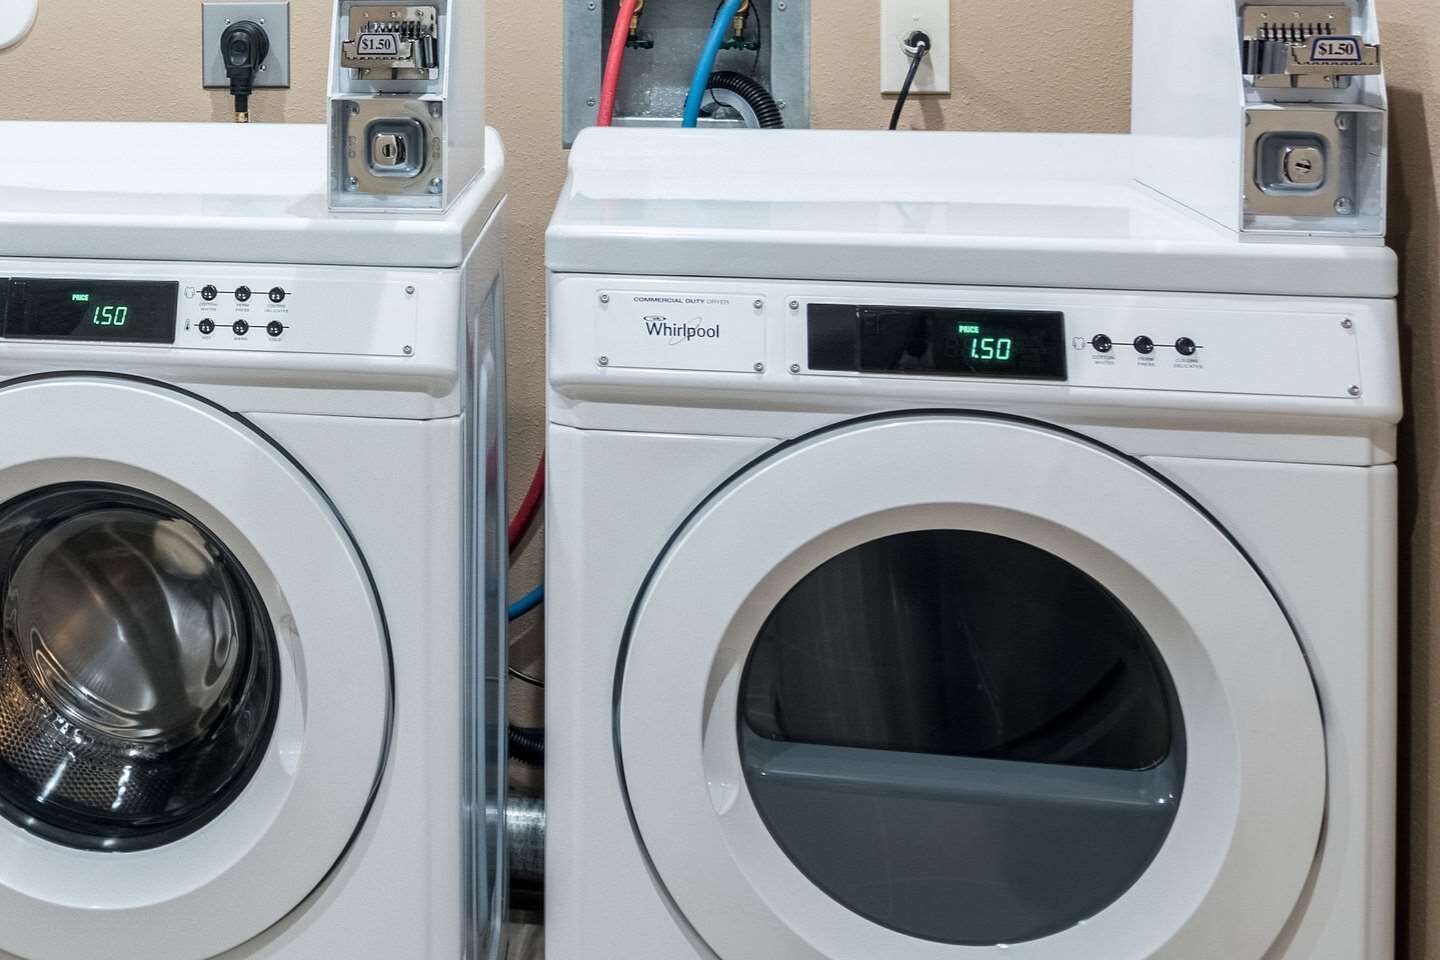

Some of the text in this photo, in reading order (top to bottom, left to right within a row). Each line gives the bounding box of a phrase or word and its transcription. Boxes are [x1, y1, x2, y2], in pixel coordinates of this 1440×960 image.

[361, 38, 391, 51] $1.50
[1318, 43, 1354, 56] $1.50
[633, 296, 683, 304] COMMERCIAL
[93, 305, 128, 326] 1.50
[646, 322, 720, 341] Whirlpool
[959, 325, 979, 333] PRICE
[971, 338, 1011, 360] 1.50
